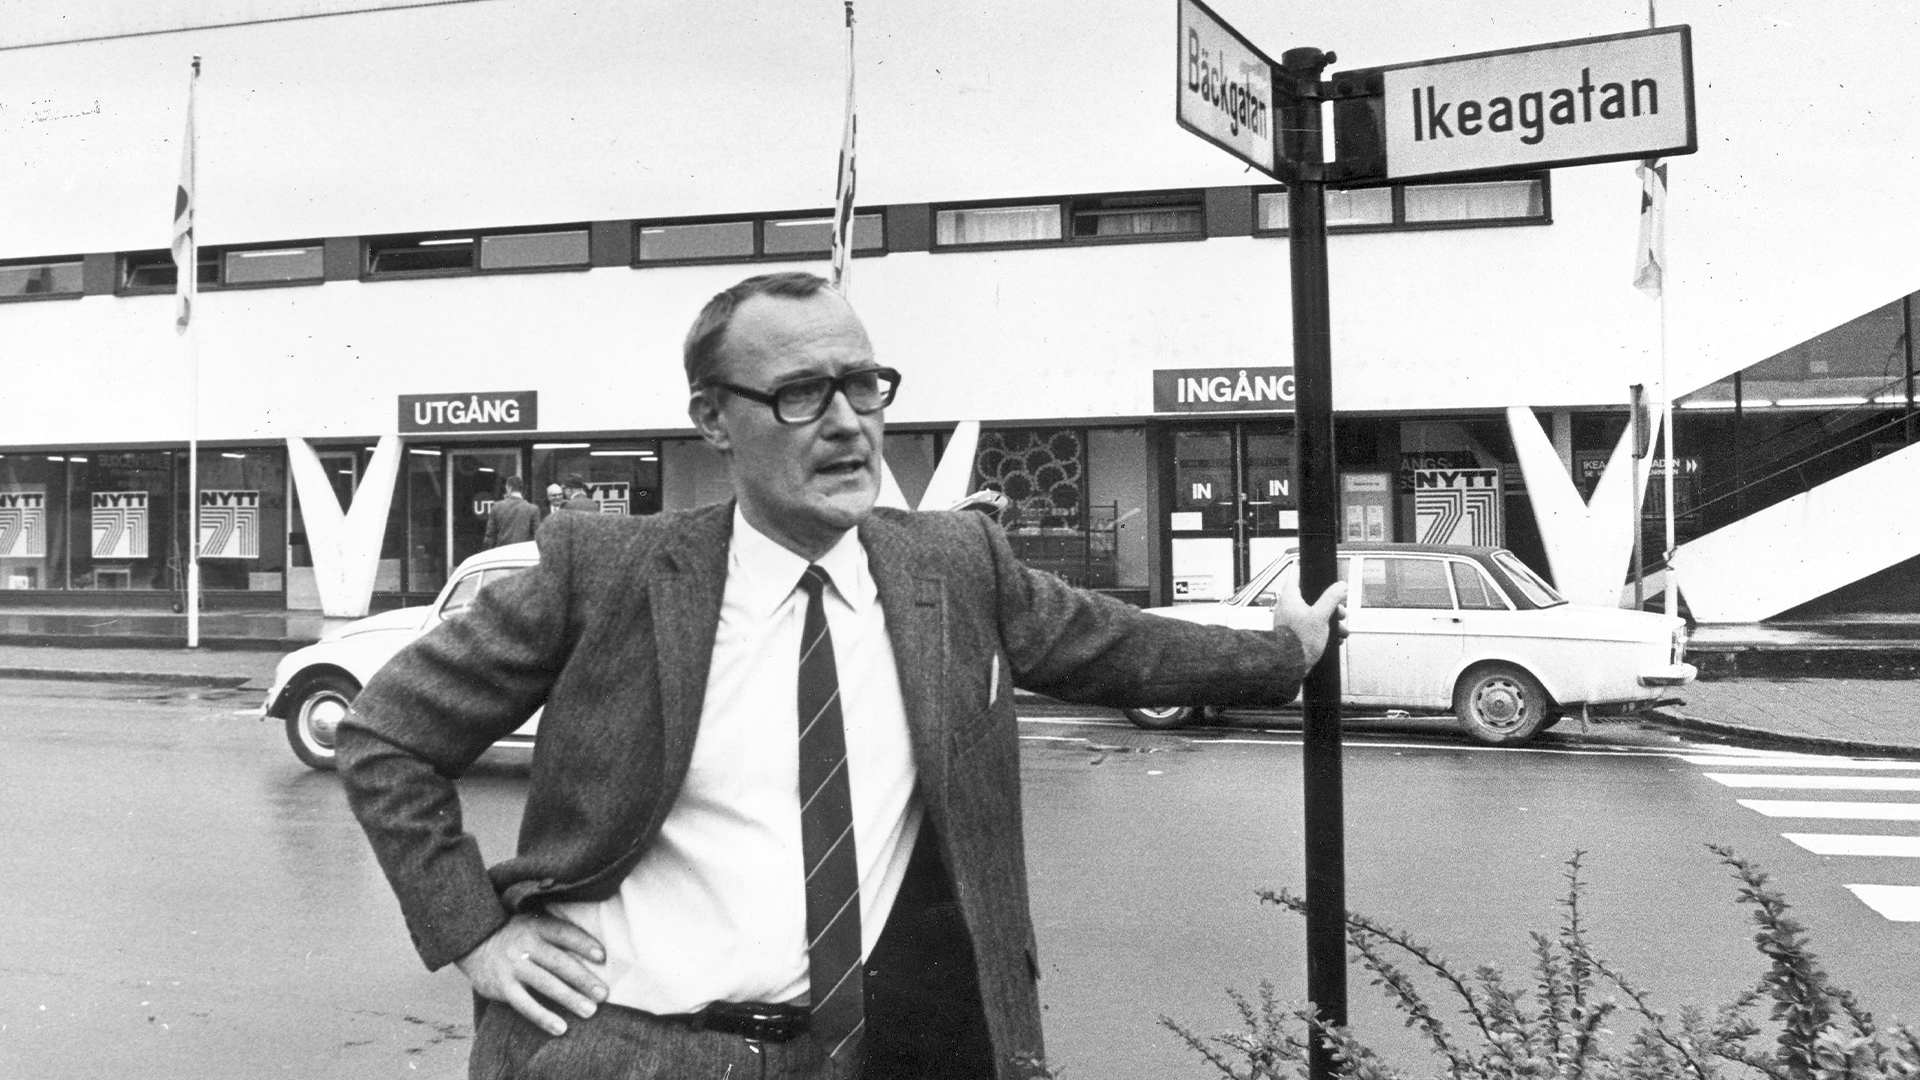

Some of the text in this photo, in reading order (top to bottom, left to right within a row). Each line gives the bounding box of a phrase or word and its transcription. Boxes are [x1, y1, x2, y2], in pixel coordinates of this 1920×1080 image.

[1189, 26, 1267, 141] Bäckgatan
[1412, 67, 1658, 145] Ikeagatan
[1178, 370, 1295, 402] INGÅNG
[415, 395, 520, 425] UTGÅNG
[584, 484, 630, 499] YTT
[1192, 483, 1212, 499] IN
[1269, 480, 1289, 496] IN
[1417, 471, 1497, 488] NYTT
[93, 493, 147, 508] NYTT
[201, 491, 259, 506] NYTT
[93, 508, 148, 556] 71
[201, 506, 260, 556] 71
[1416, 488, 1499, 547] 71
